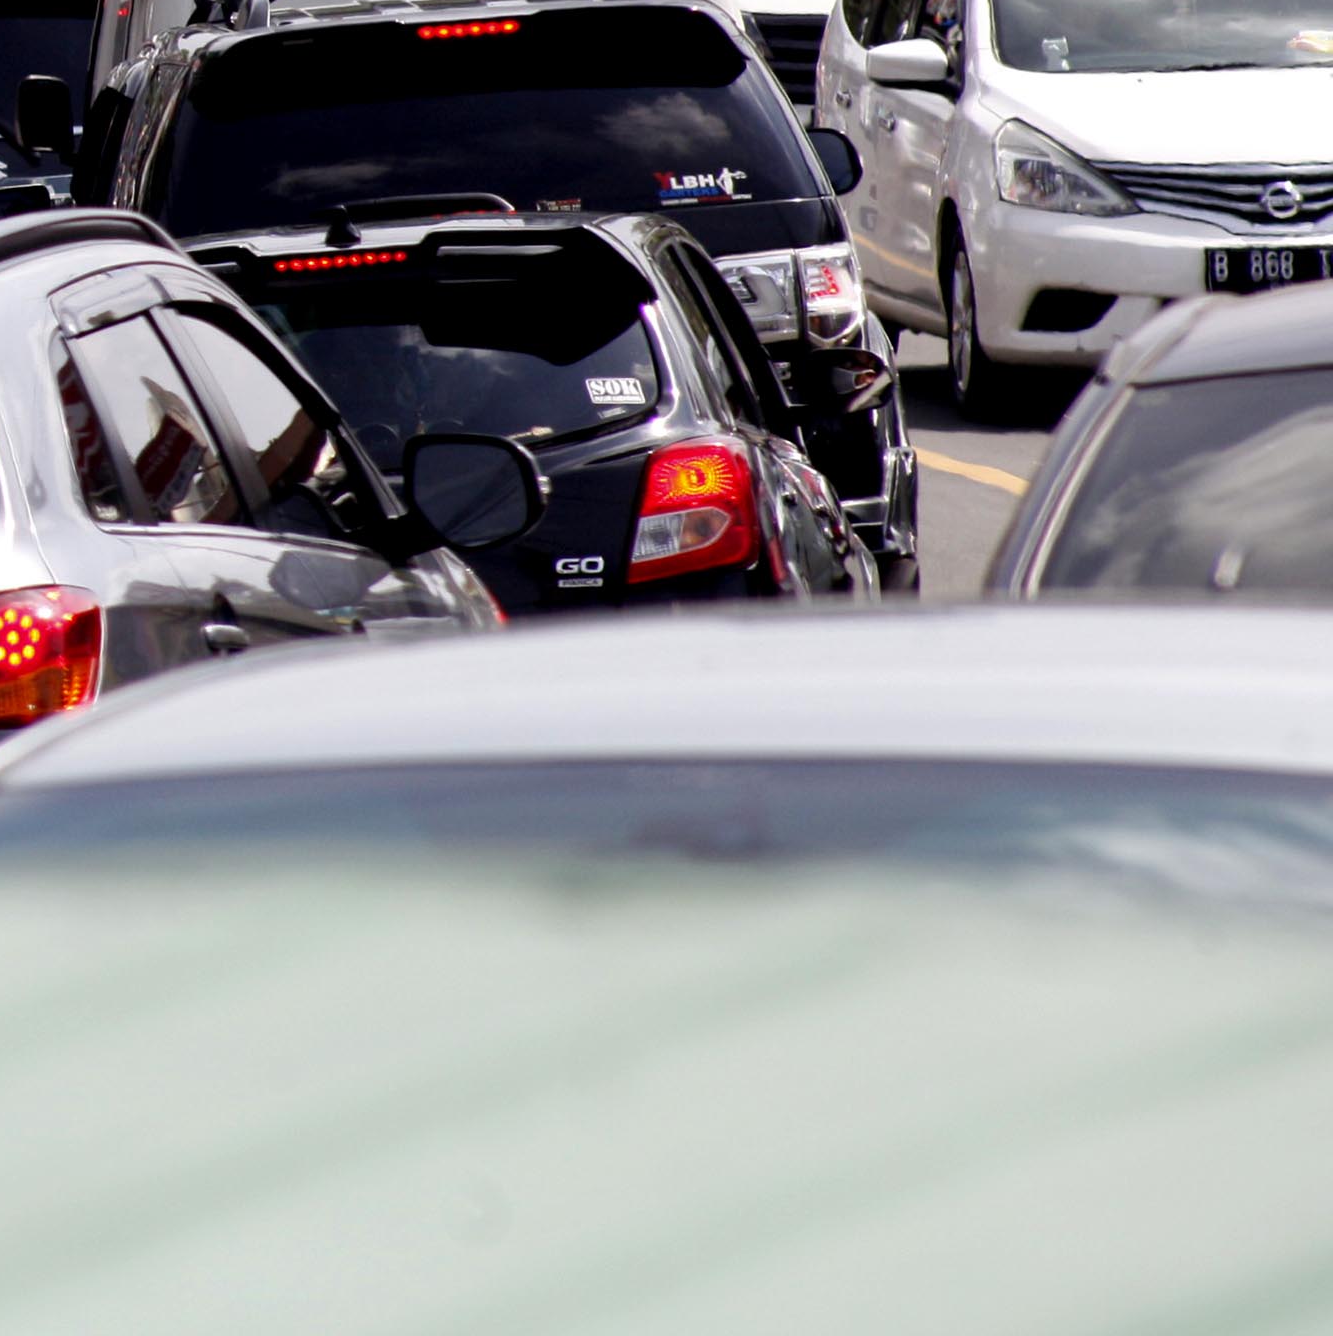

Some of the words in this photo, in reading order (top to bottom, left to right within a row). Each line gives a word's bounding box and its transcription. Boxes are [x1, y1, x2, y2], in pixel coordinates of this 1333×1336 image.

[1214, 249, 1229, 283] B
[1249, 249, 1294, 282] 868
[555, 556, 605, 575] GO
